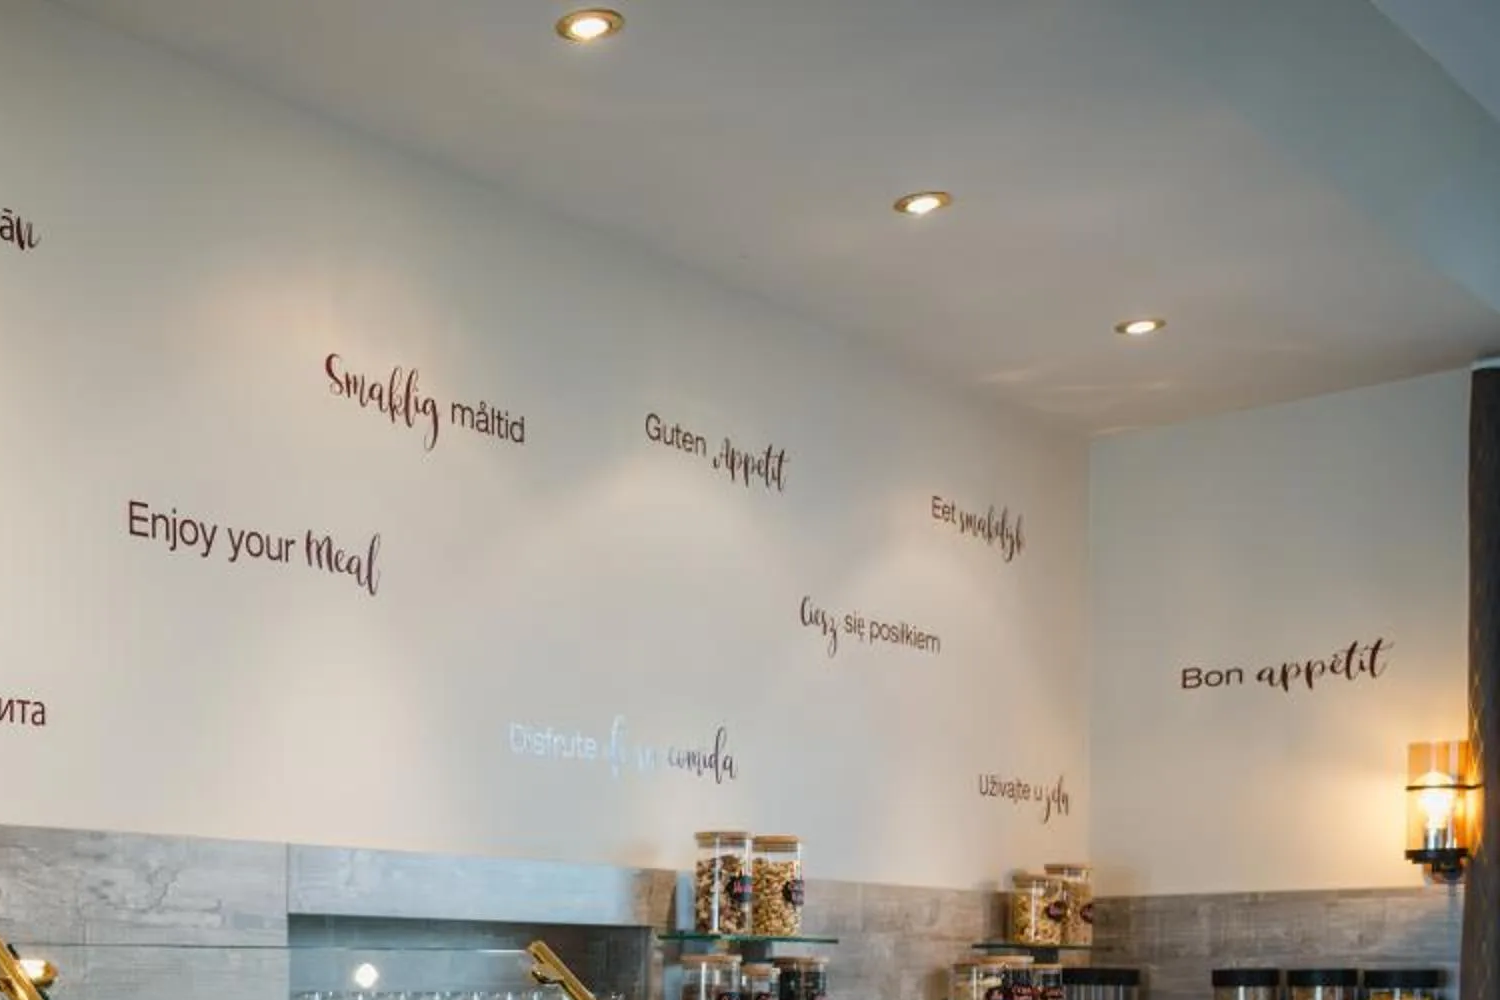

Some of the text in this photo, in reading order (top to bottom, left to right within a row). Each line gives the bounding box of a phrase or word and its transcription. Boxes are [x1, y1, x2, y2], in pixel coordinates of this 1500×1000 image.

[325, 353, 526, 451] Smaklig måltid
[645, 412, 791, 492] Guten Appetit
[128, 500, 382, 596] Enjoy your Meal
[1181, 666, 1244, 690] Bon
[667, 726, 738, 784] comida
